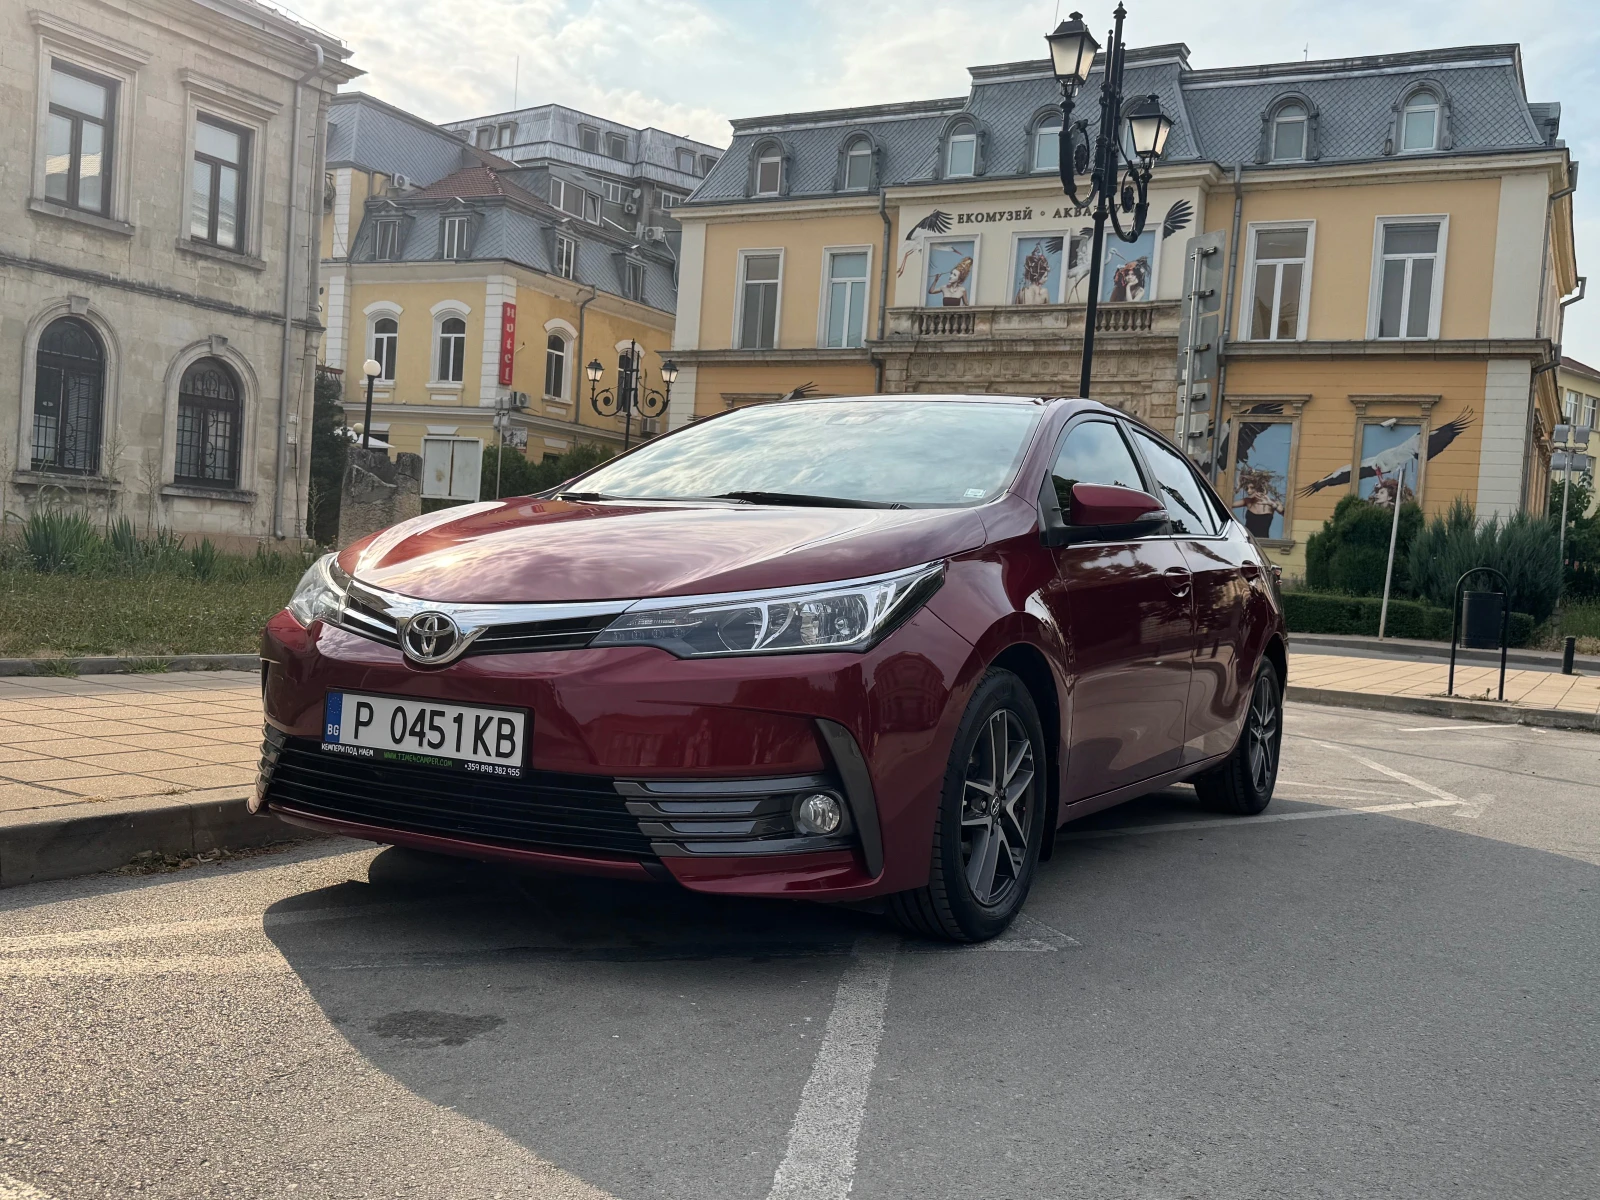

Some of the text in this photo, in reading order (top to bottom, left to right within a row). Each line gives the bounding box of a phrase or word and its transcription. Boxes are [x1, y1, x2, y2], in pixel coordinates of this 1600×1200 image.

[957, 206, 1033, 224] ЕКОМУЗЕЙ
[353, 701, 374, 740] P
[327, 723, 340, 736] BG
[345, 746, 358, 756] ПОД
[358, 749, 374, 757] НАЕМ
[480, 764, 493, 773] 898
[494, 766, 507, 775] 382
[507, 768, 520, 777] 955
